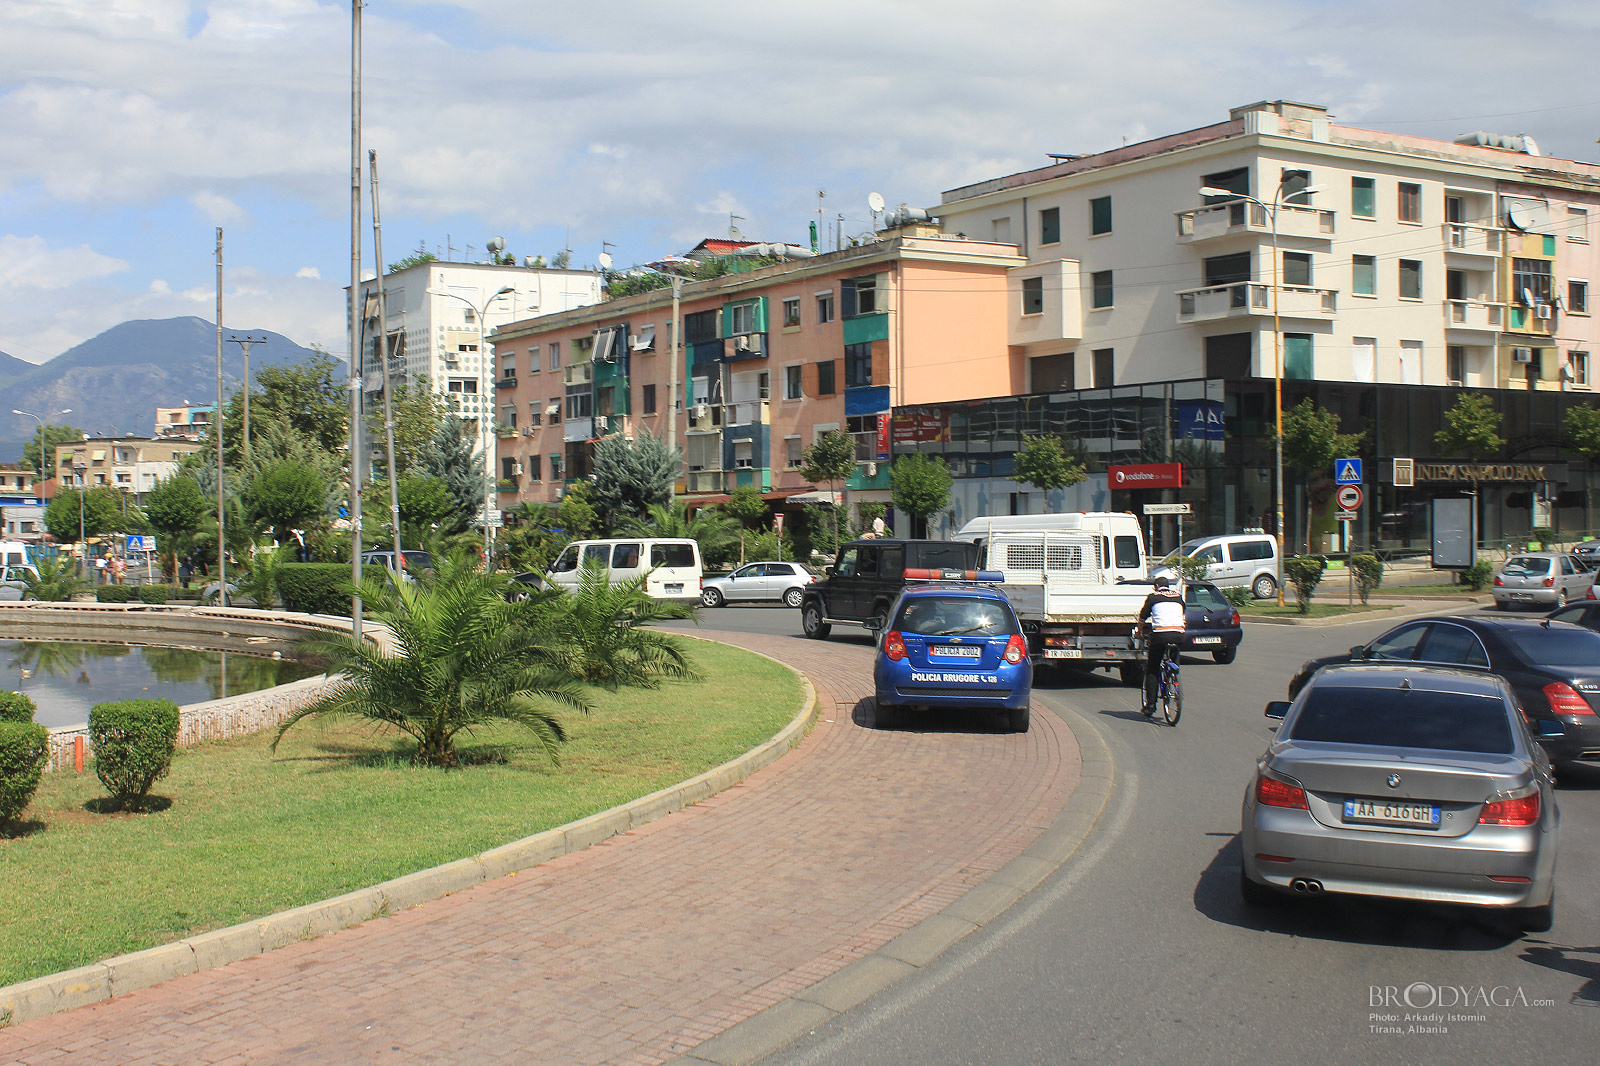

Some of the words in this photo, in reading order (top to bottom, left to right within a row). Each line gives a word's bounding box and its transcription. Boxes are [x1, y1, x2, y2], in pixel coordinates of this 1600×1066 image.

[1125, 472, 1155, 480] vodafone
[1416, 464, 1457, 480] INTESA
[1515, 465, 1548, 480] BANK
[911, 673, 941, 682] POLICIA
[943, 674, 980, 683] RRUGORE
[1358, 801, 1375, 817] AA
[1383, 803, 1410, 819] 616
[1412, 805, 1430, 821] GH
